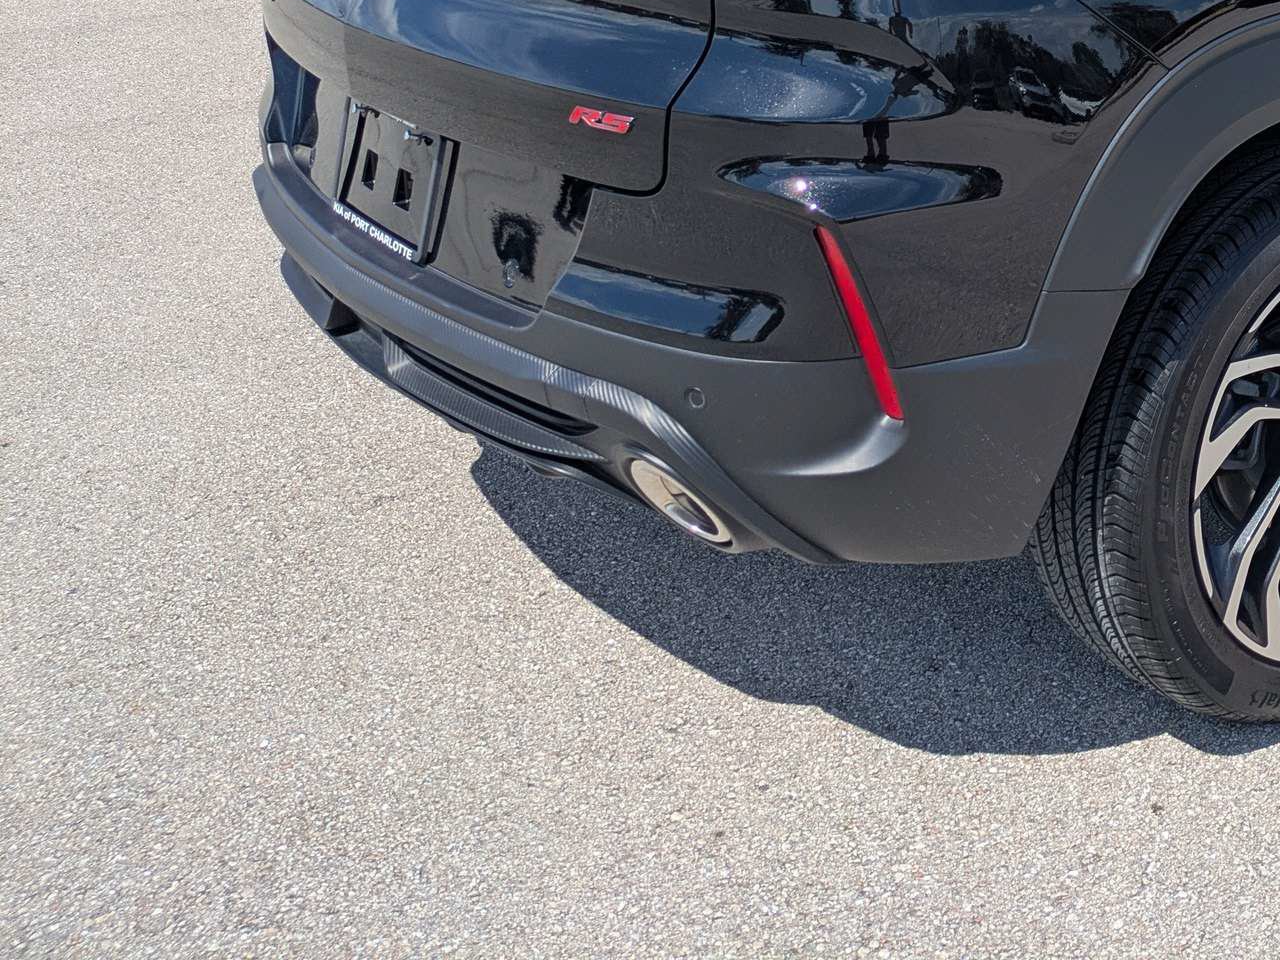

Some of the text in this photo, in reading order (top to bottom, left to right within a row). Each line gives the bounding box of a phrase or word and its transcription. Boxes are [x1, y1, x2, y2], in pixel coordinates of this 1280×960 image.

[569, 105, 635, 134] RS
[333, 201, 413, 261] KIA of PORT CHARLOTTE
